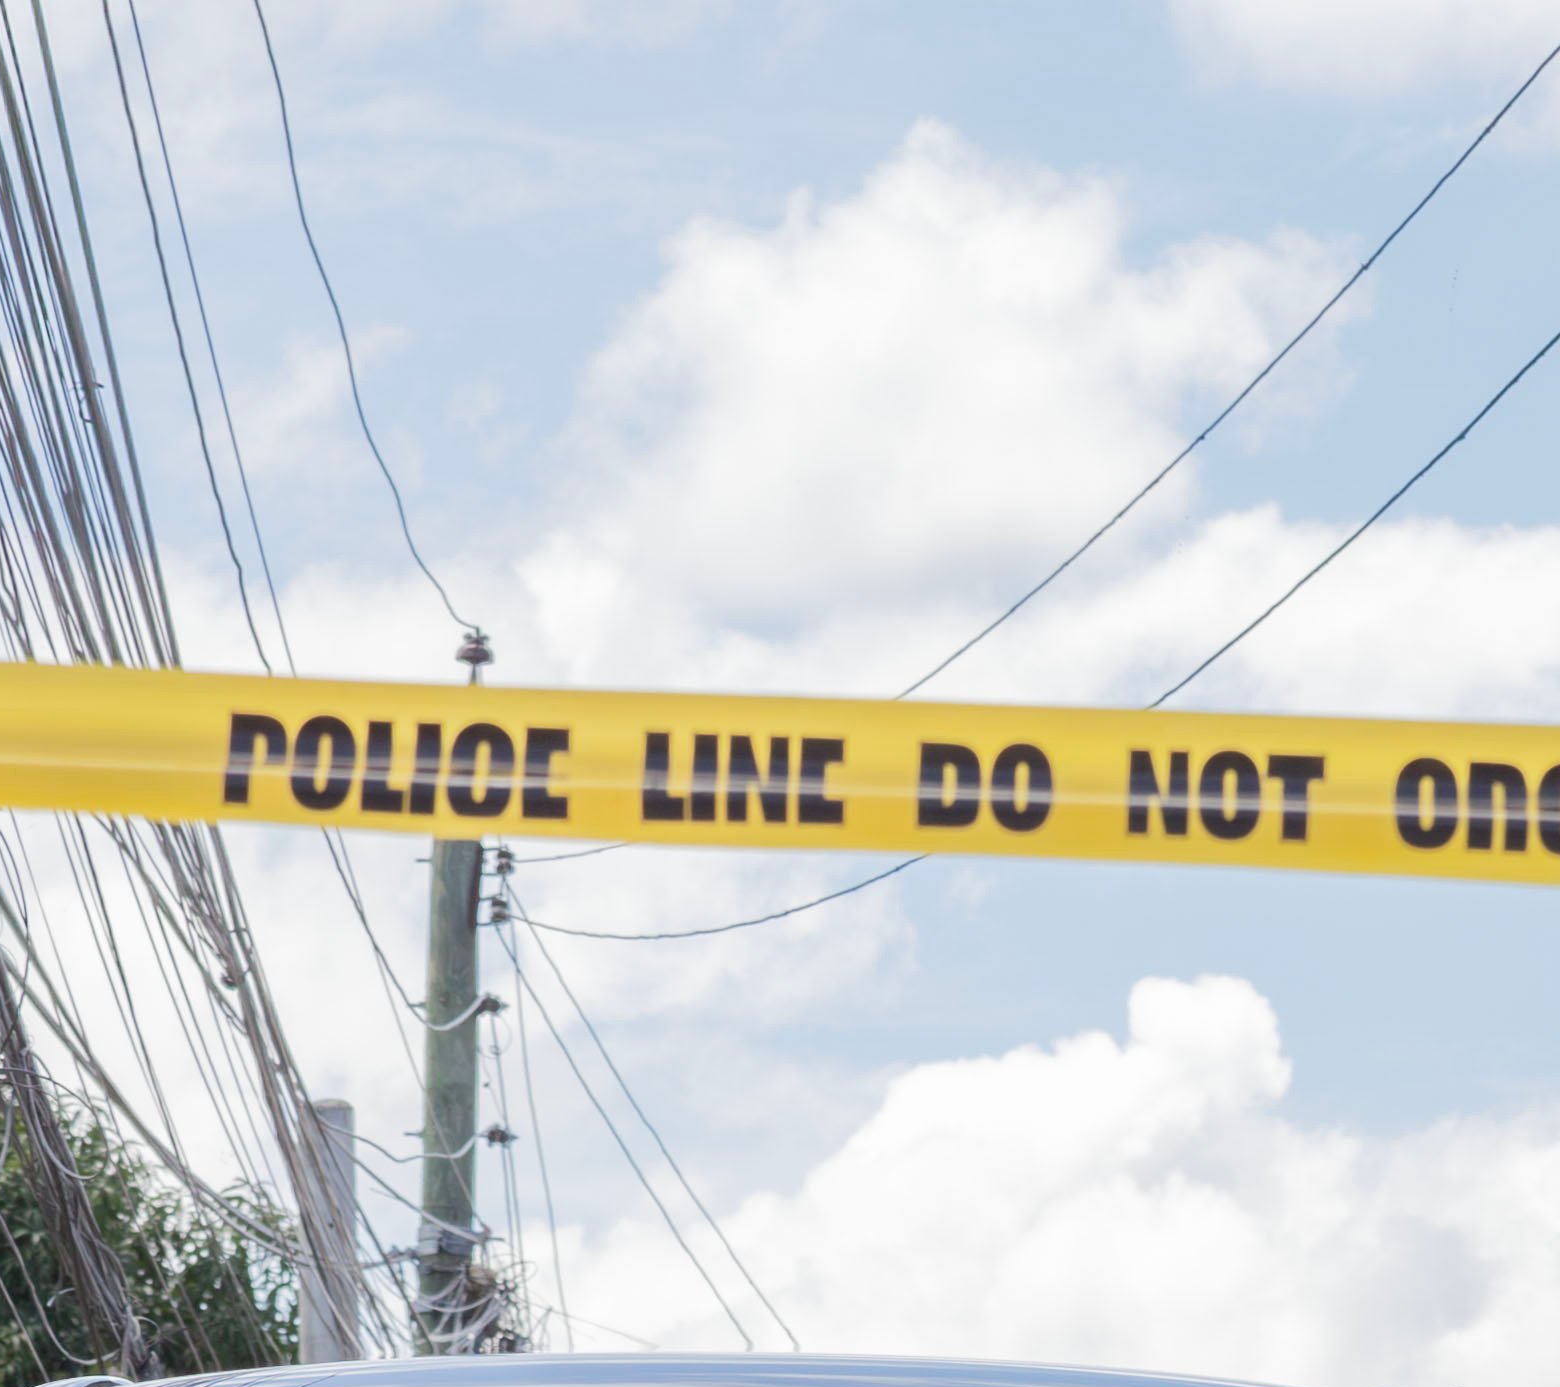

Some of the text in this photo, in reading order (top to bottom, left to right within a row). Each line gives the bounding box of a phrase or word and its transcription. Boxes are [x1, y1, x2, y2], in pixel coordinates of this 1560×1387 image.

[224, 714, 570, 820] POLICE
[642, 732, 845, 824] LINE
[918, 743, 1053, 832] DO
[1128, 750, 1324, 841] NOT
